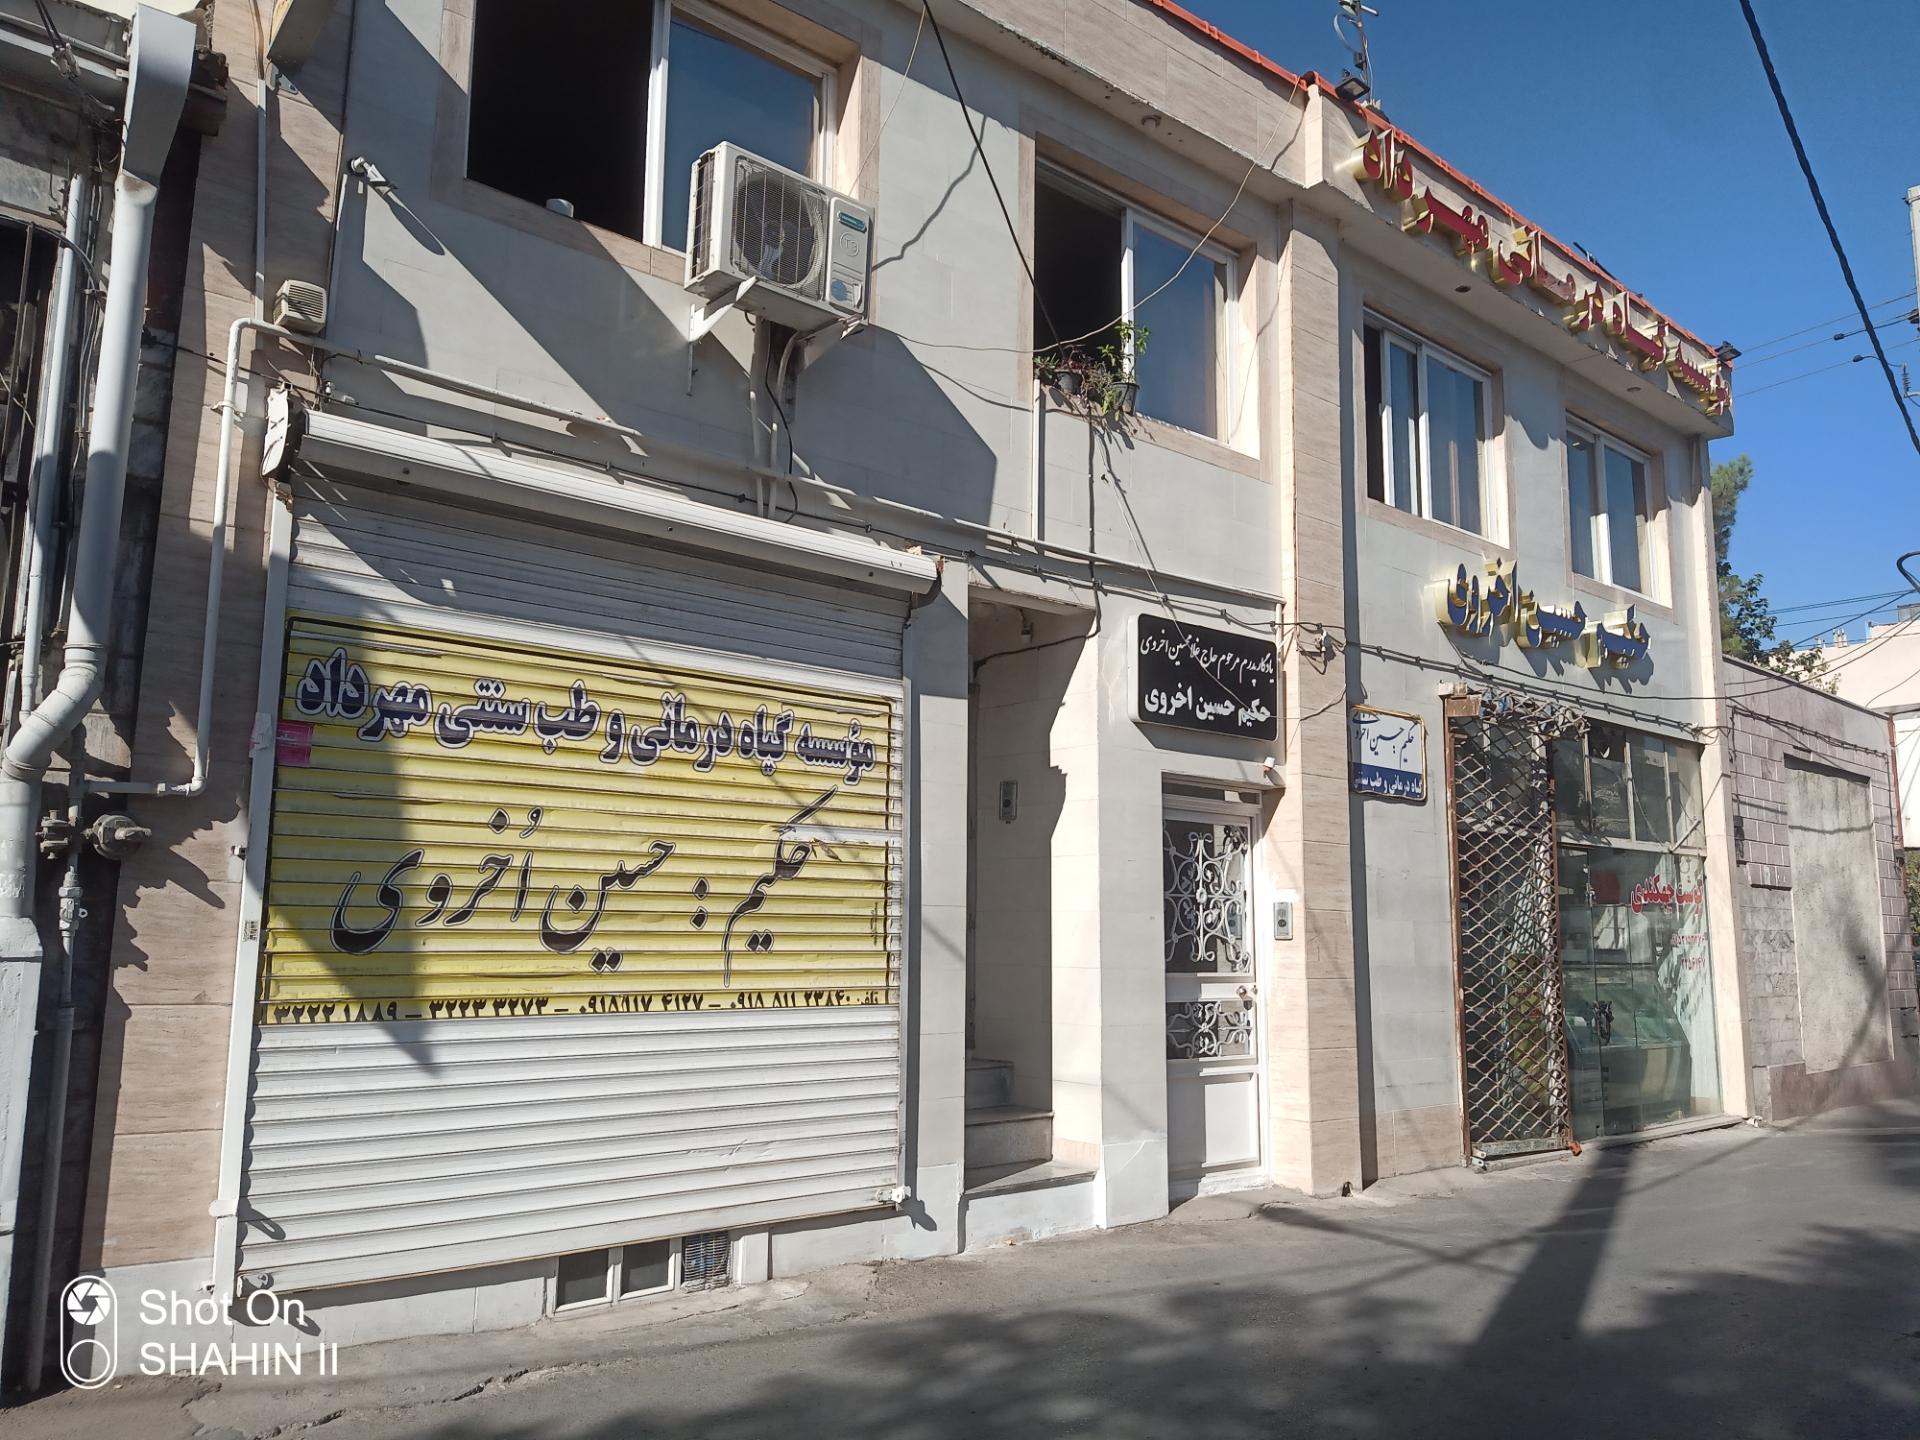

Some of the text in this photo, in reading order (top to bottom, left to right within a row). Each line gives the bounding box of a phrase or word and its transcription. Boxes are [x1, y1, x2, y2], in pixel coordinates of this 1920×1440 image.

[1140, 629, 1168, 654] اخروی
[1522, 590, 1587, 648] حسین
[1200, 647, 1217, 667] حاج
[1217, 652, 1239, 679] مرحوم
[434, 678, 531, 749] سنتی
[534, 679, 600, 755] طب
[599, 707, 626, 763] و
[627, 691, 735, 773] درمانی
[1145, 682, 1271, 726] حکیم حسین اخروی
[737, 704, 795, 776] گیاه
[539, 841, 677, 974] حسین
[721, 785, 838, 988] حکیم
